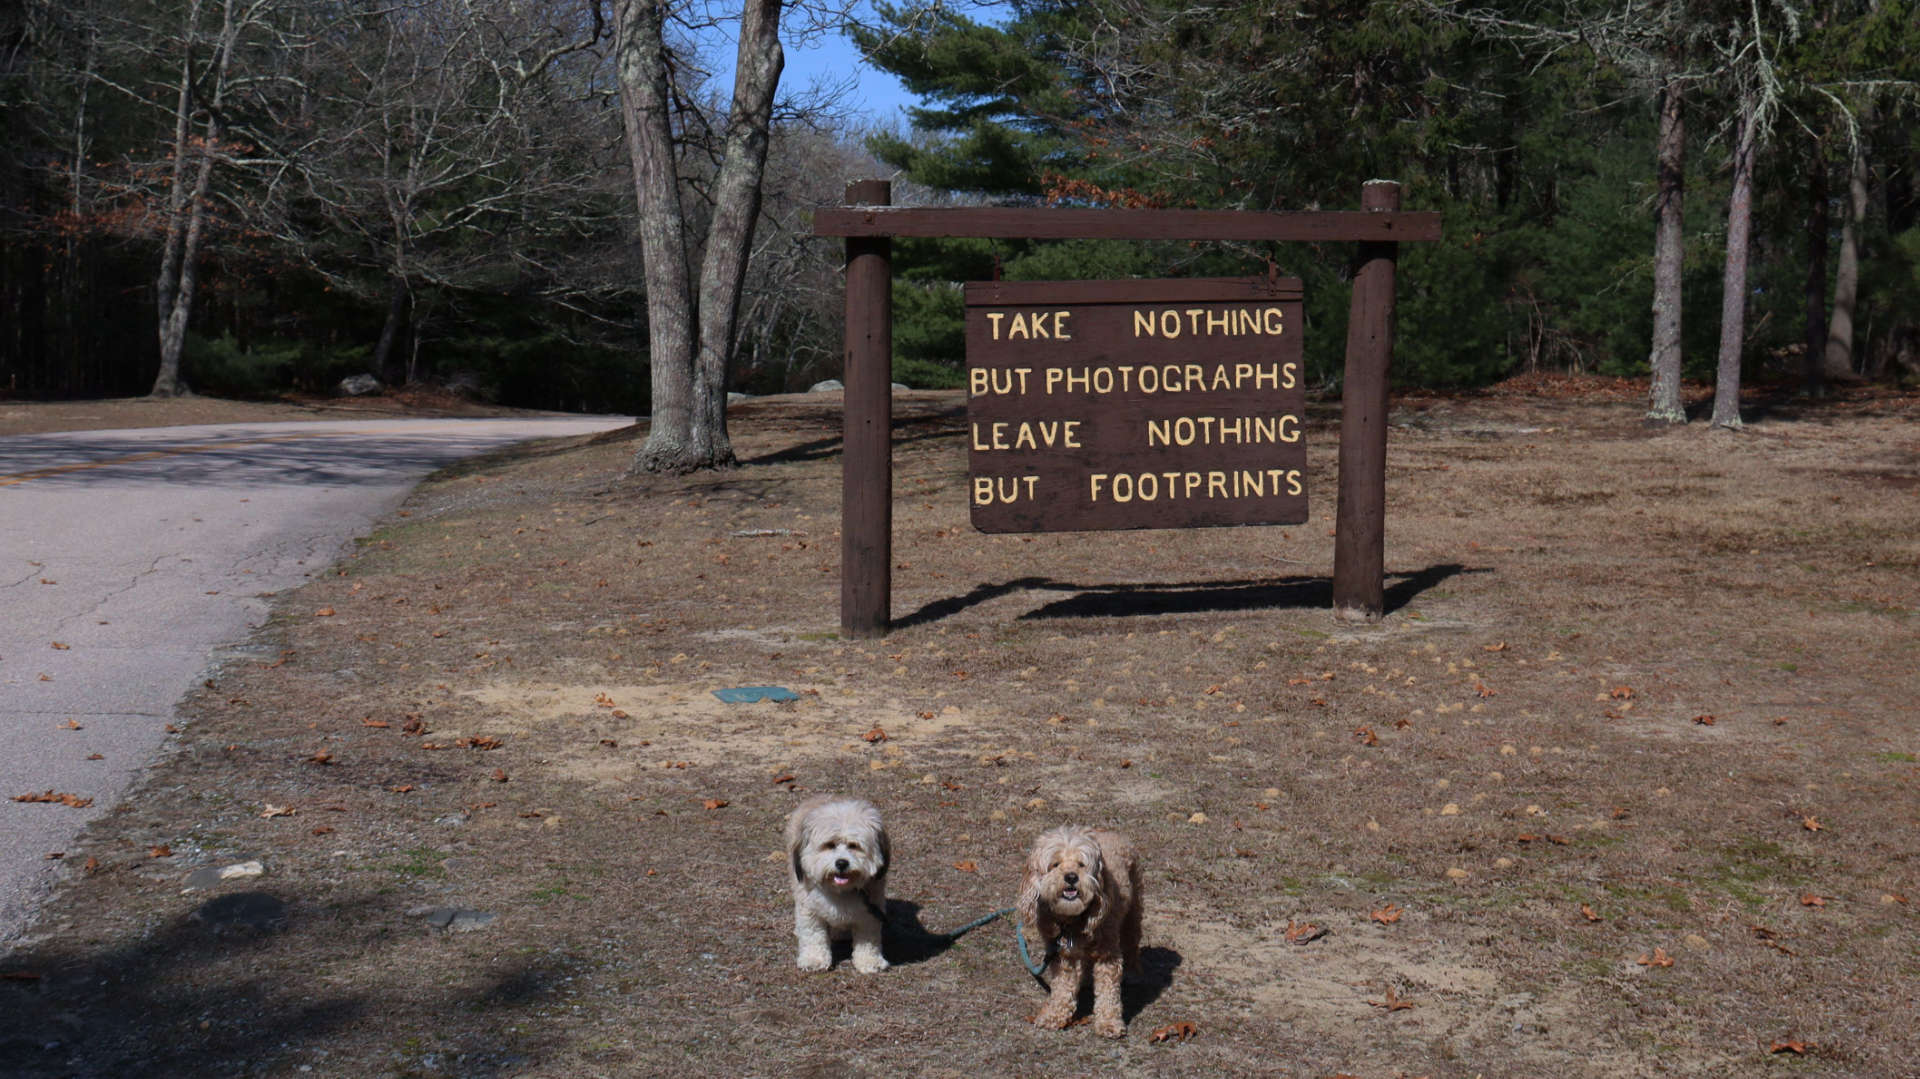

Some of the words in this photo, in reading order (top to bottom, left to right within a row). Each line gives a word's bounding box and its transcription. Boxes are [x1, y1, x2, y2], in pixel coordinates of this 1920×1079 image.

[986, 311, 1072, 340] TAKE
[1134, 308, 1284, 339] NOTHING
[970, 367, 1032, 397] BUT
[1046, 362, 1297, 395] PHOTOGRAPHS
[972, 421, 1082, 451] LEAVE
[1148, 415, 1301, 447] NOTHING
[974, 475, 1040, 505] BUT
[1090, 470, 1303, 503] FOOTPRINTS
